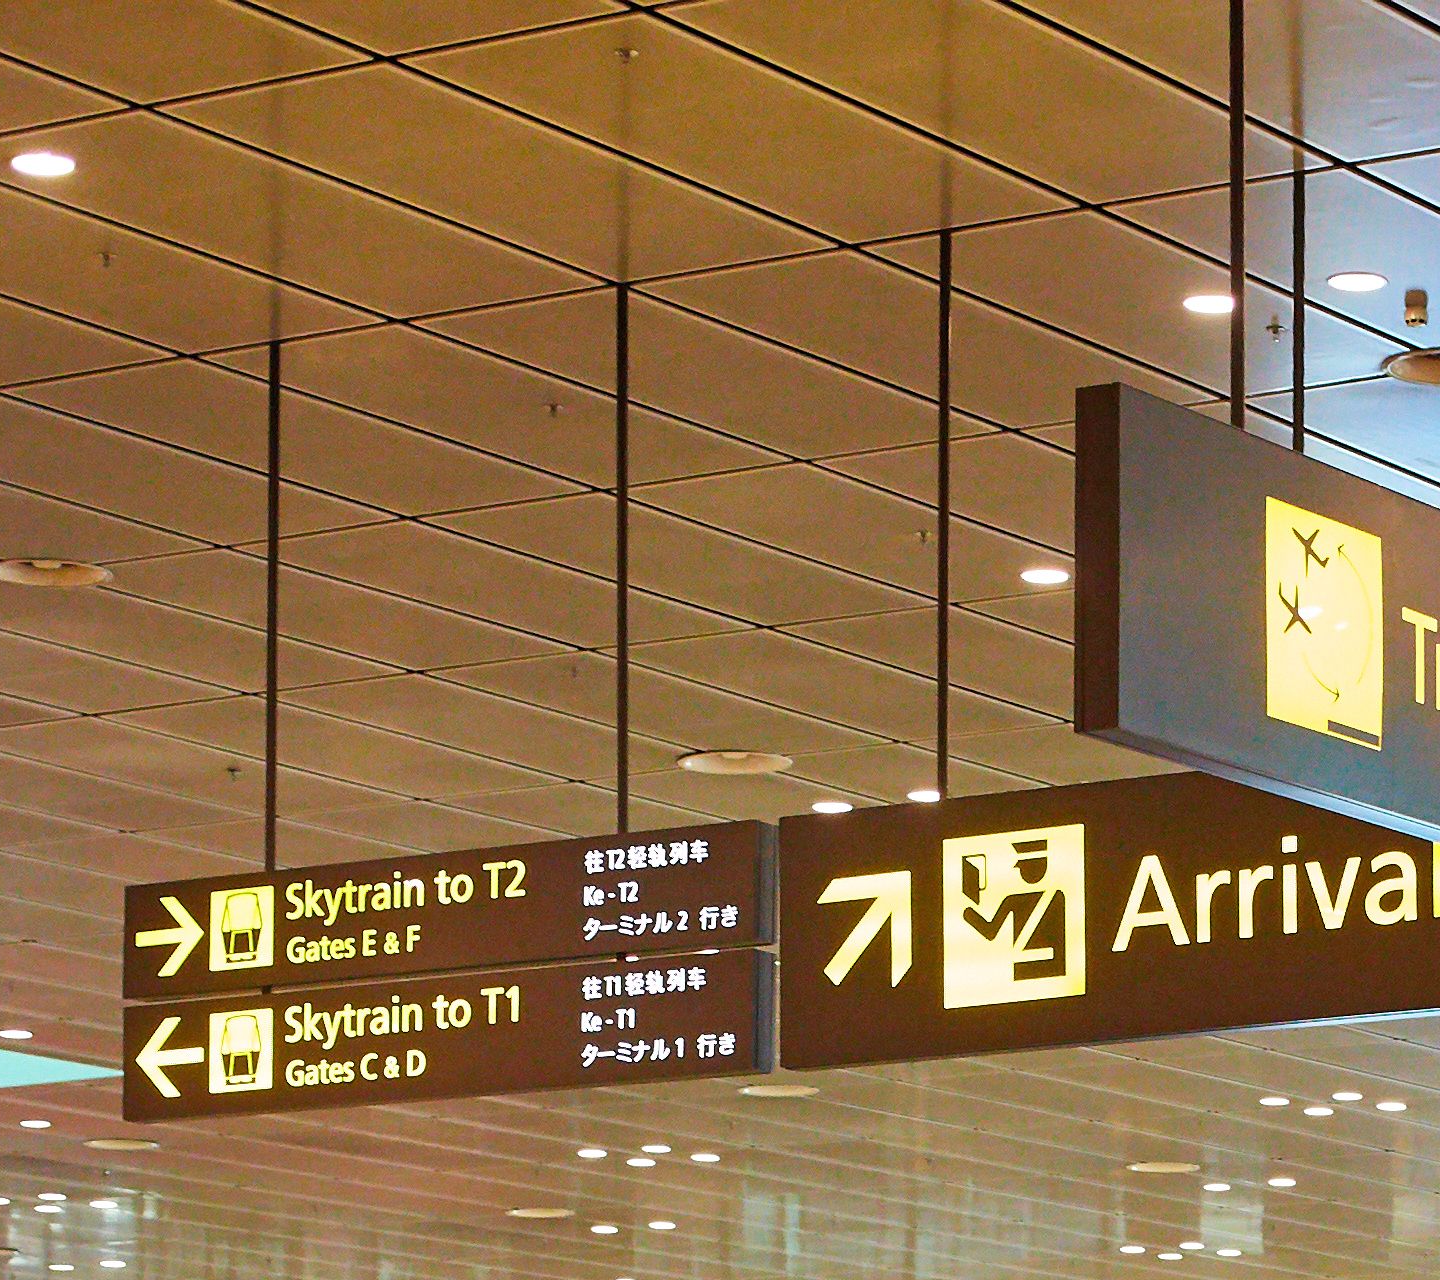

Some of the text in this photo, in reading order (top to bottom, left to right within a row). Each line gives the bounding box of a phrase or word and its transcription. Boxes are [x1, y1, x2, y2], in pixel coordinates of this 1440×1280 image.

[285, 860, 527, 922] Skytrain to T2
[286, 925, 421, 964] Gates E & F
[284, 986, 521, 1045] Skytrain to T1
[285, 1049, 426, 1088] Gates C & D
